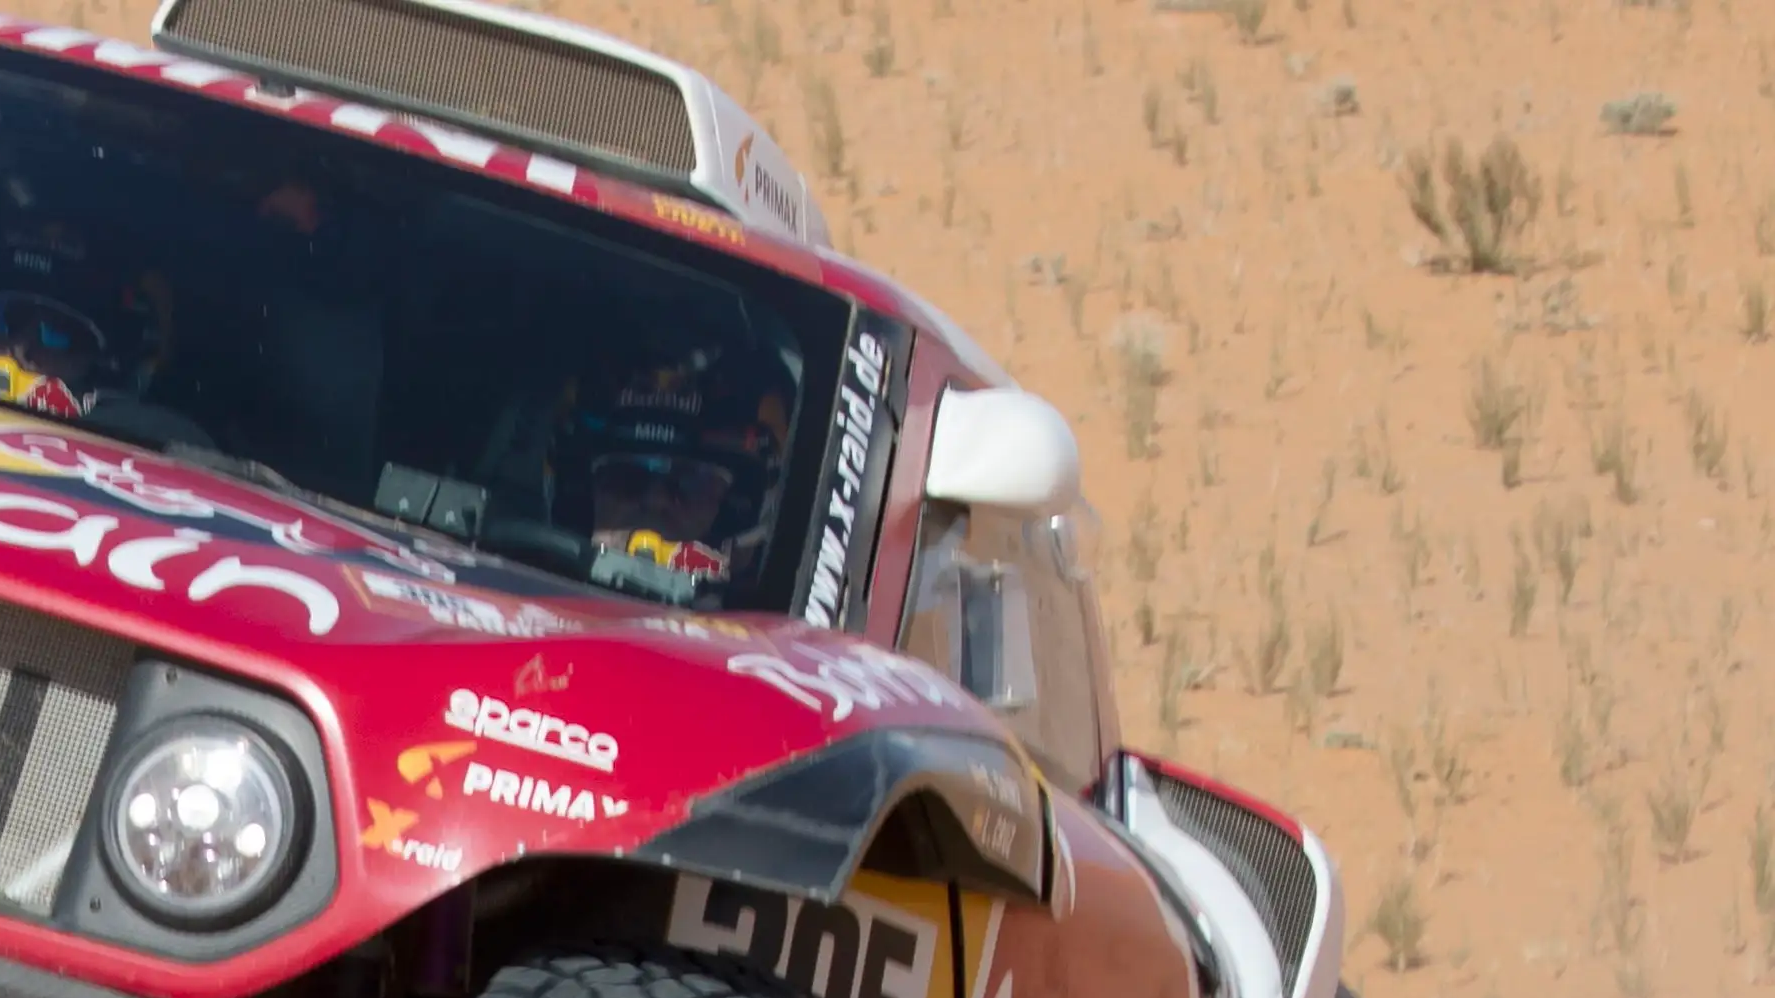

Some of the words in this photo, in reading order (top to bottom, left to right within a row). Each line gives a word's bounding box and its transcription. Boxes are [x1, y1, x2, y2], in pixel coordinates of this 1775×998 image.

[754, 160, 798, 236] PRIMAX
[635, 422, 676, 444] MINI
[444, 688, 619, 774] sparco
